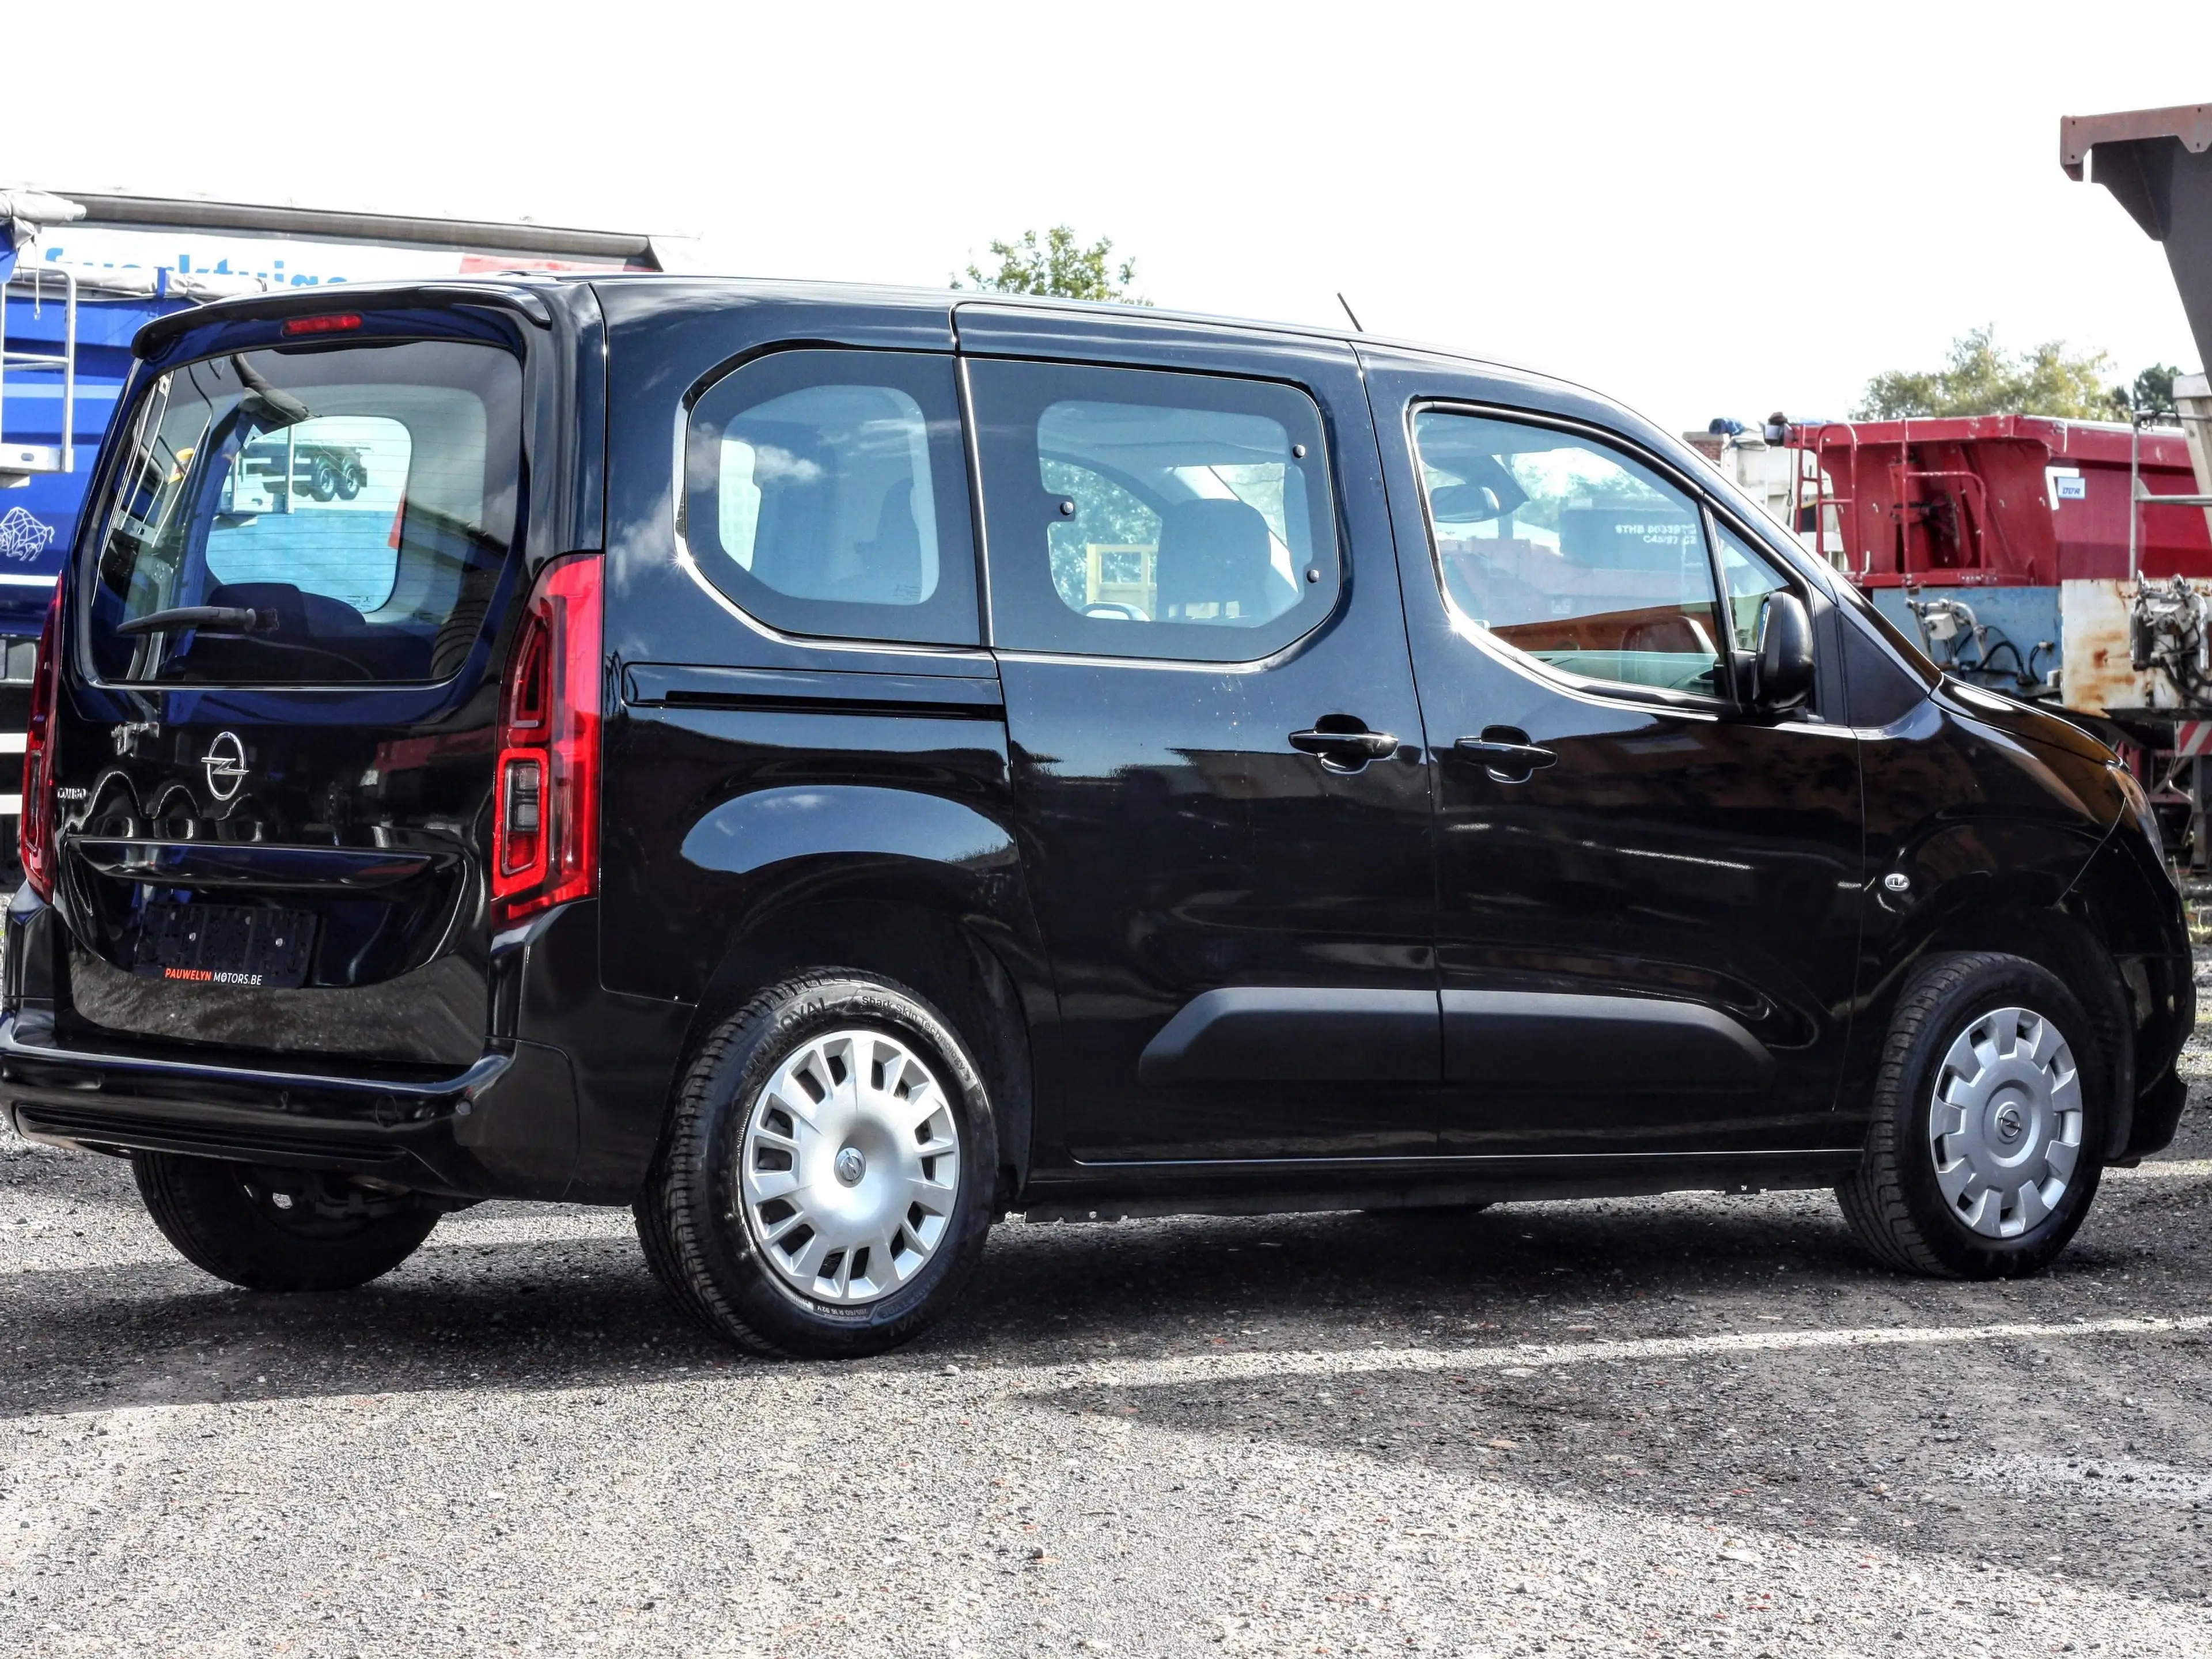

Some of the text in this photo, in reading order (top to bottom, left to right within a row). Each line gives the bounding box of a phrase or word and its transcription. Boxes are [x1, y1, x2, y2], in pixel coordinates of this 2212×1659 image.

[165, 968, 263, 986] PAUWELYN MOTORS.BE
[862, 996, 966, 1071] Shark Skin Technology
